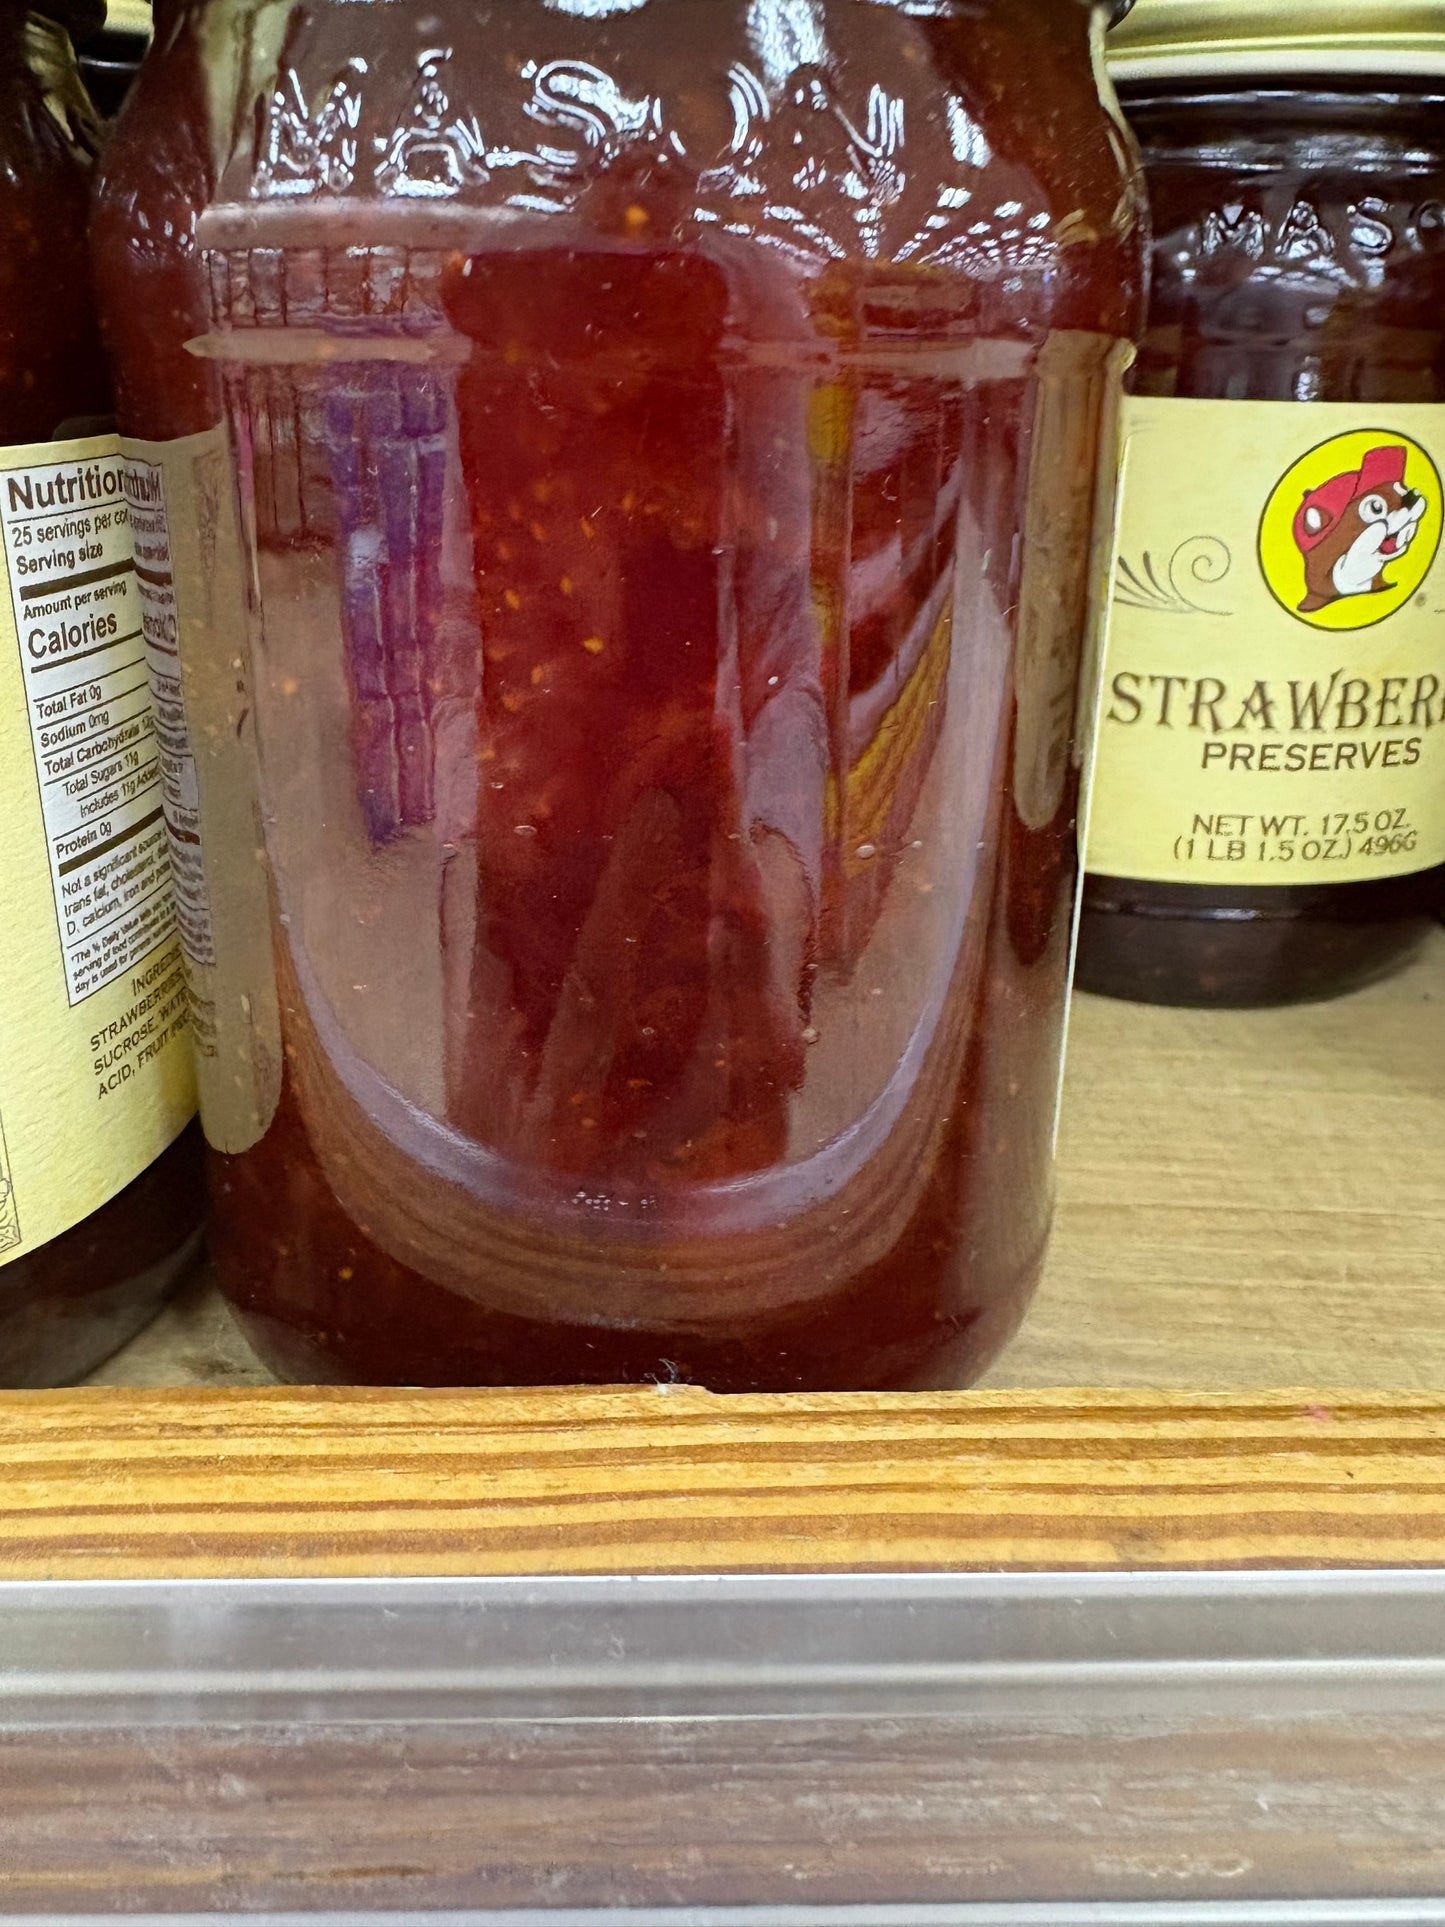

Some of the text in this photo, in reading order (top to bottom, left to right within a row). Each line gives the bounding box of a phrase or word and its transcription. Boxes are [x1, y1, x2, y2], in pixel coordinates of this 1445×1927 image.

[12, 526, 32, 548] 25
[37, 517, 91, 543] servings
[95, 511, 111, 535] per
[17, 540, 103, 576] Serving size
[23, 596, 72, 621] Amount
[75, 593, 92, 610] per
[94, 579, 127, 600] serving
[28, 612, 118, 659] Calories
[36, 684, 102, 719] Total Fat 0g
[1106, 667, 1445, 733] STRAWBER
[41, 711, 110, 748] Sodium 0mg
[44, 754, 74, 776] Total
[1201, 737, 1422, 772] PRESERVES
[62, 774, 88, 796] Total
[90, 760, 122, 785] Sugars
[80, 790, 119, 818] Includes
[56, 821, 112, 859] Protein 0g
[1192, 814, 1254, 836] NET
[1260, 814, 1309, 837] WT.
[1374, 808, 1411, 831] OZ.
[1173, 836, 1194, 861] (1
[1207, 839, 1246, 861] LB
[1258, 839, 1295, 862] 1.5
[62, 877, 82, 898] Not
[64, 894, 91, 917] trans
[98, 1063, 135, 1100] ACID,
[137, 1030, 168, 1068] FRUIT
